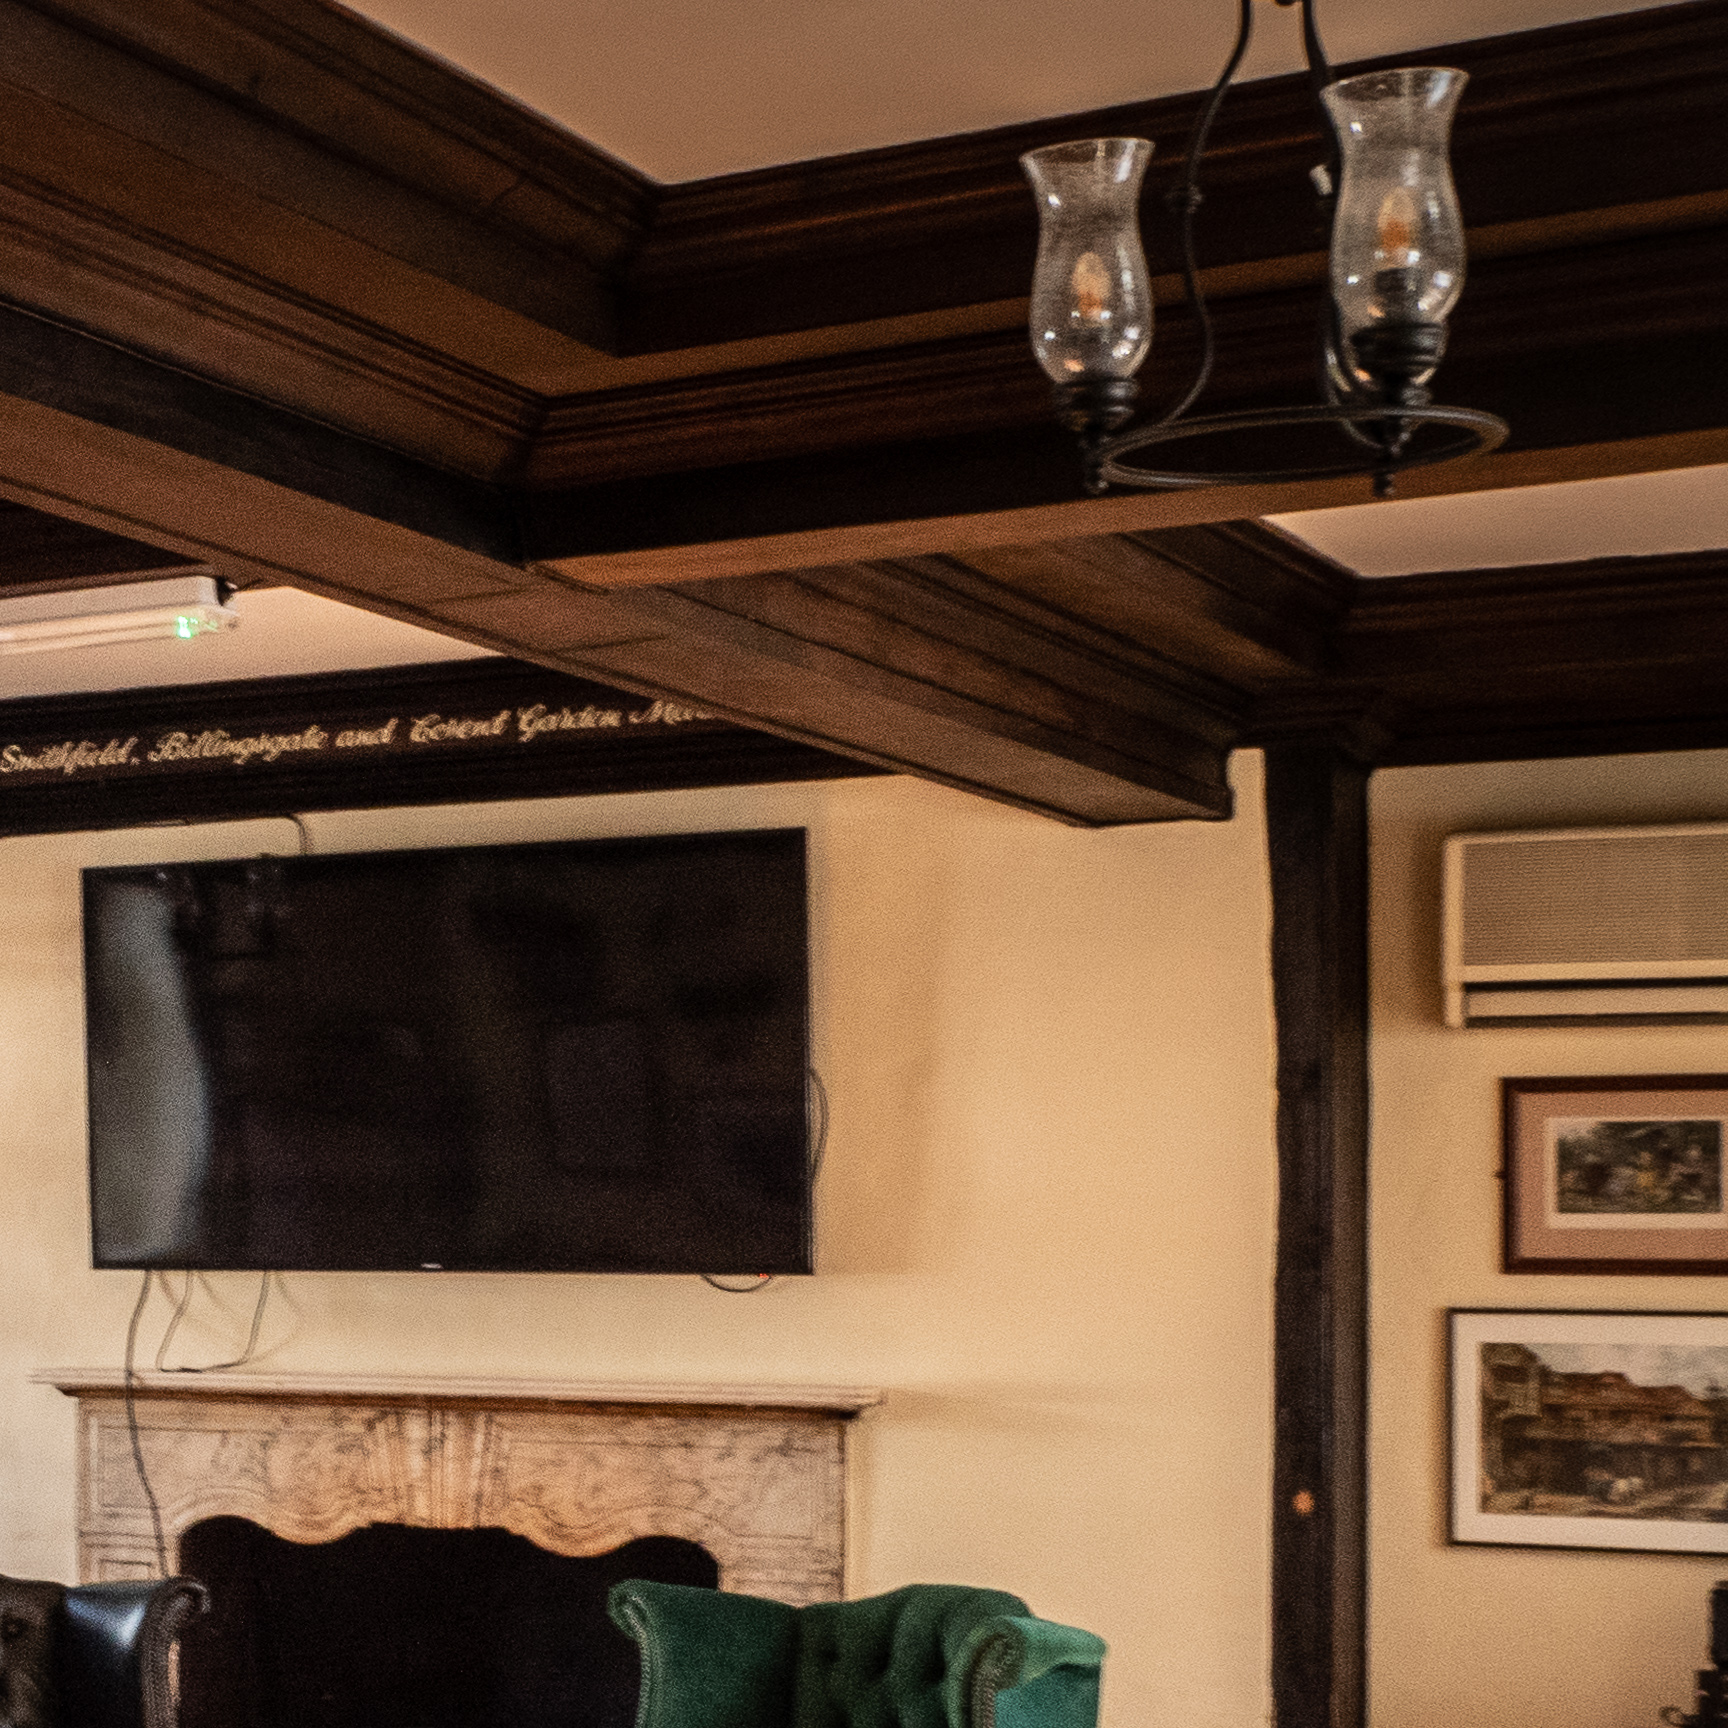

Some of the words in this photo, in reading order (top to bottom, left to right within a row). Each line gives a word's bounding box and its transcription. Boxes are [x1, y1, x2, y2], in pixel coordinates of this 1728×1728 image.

[335, 717, 399, 748] and
[409, 709, 511, 743] Covent
[518, 703, 622, 741] Garden
